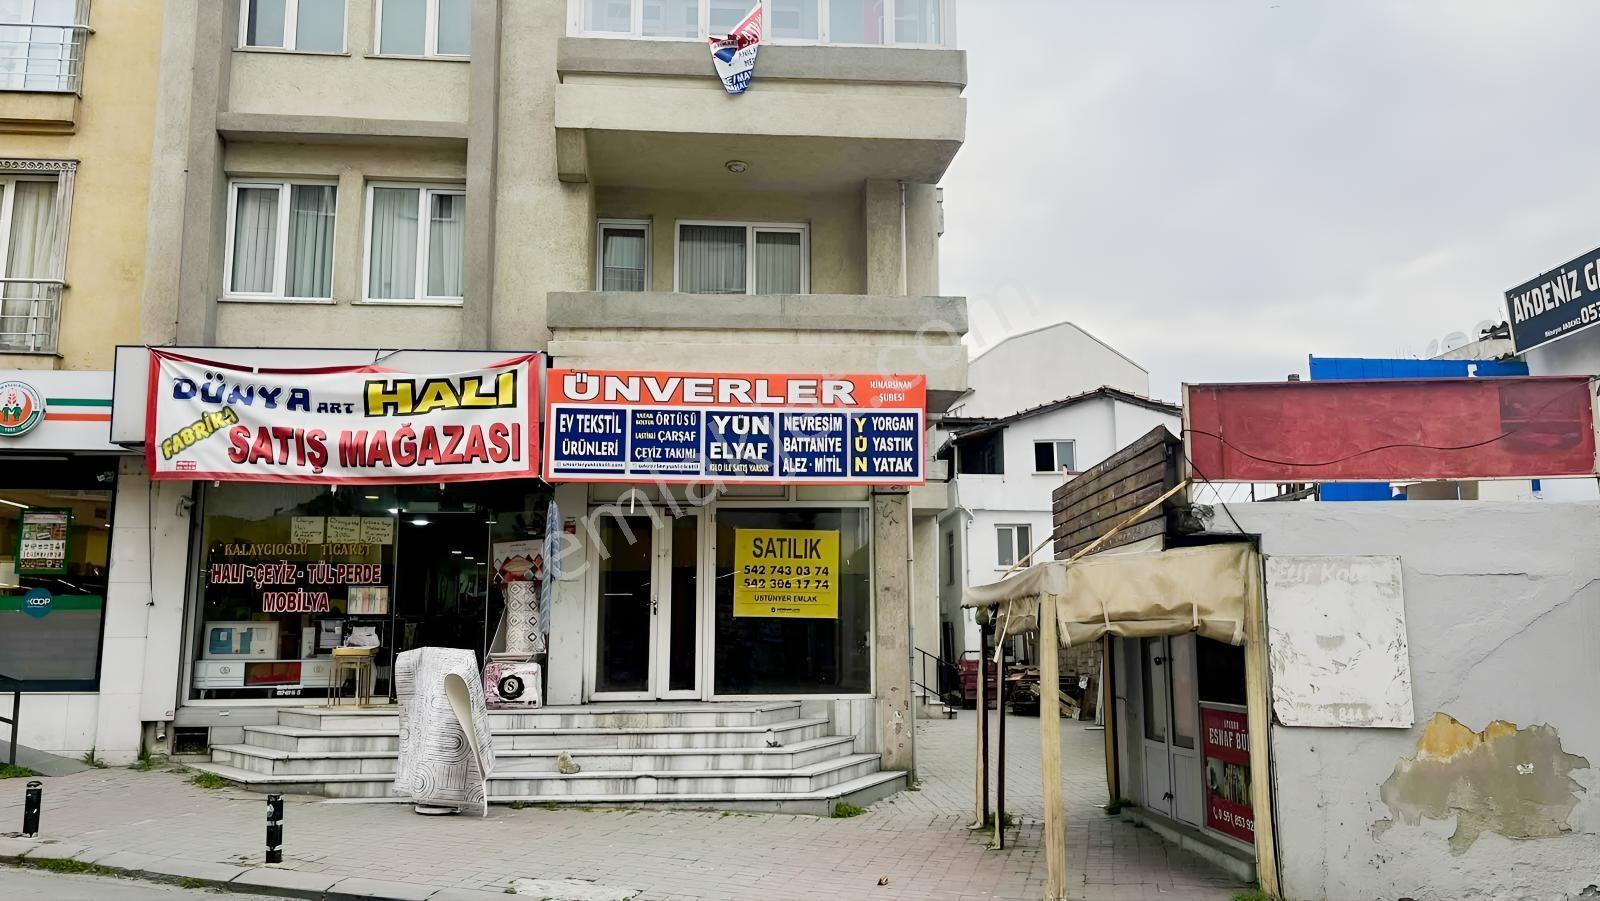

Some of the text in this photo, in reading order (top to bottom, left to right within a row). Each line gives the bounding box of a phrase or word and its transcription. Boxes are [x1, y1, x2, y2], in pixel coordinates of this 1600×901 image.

[1513, 268, 1582, 324] AKDENİZ
[172, 369, 518, 417] DÜNYA ART HALI
[563, 372, 858, 404] ÜNVERLER
[560, 412, 622, 433] EV TEKSTİL
[656, 411, 697, 426] ÖRTÜSÜ
[713, 415, 769, 435] YÜN
[784, 413, 842, 431] NEVRESİM
[871, 416, 914, 431] YORGAN
[161, 405, 239, 460] FABRİKA
[658, 431, 696, 443] ÇARŞAF
[228, 422, 520, 473] SATIŞ MAĞAZASI
[562, 439, 618, 455] ÜRÜNLERİ
[635, 446, 696, 459] ÇEYİZ TAKIMI
[710, 442, 768, 459] ELYAF
[783, 436, 842, 453] BATTANİYE
[872, 437, 913, 452] YASTIK
[783, 455, 842, 473] ALEZ MİTİL
[872, 457, 913, 472] YATAK
[752, 537, 822, 559] SATILIK
[211, 560, 381, 589] HALI ÇEYİZ TÜL PERDE
[744, 565, 829, 576] 542 743 03 74
[744, 578, 829, 589] 542 306 17 74
[263, 588, 330, 612] MOBİLYA
[793, 595, 817, 603] EMLAK
[1209, 727, 1233, 748] ESNAF
